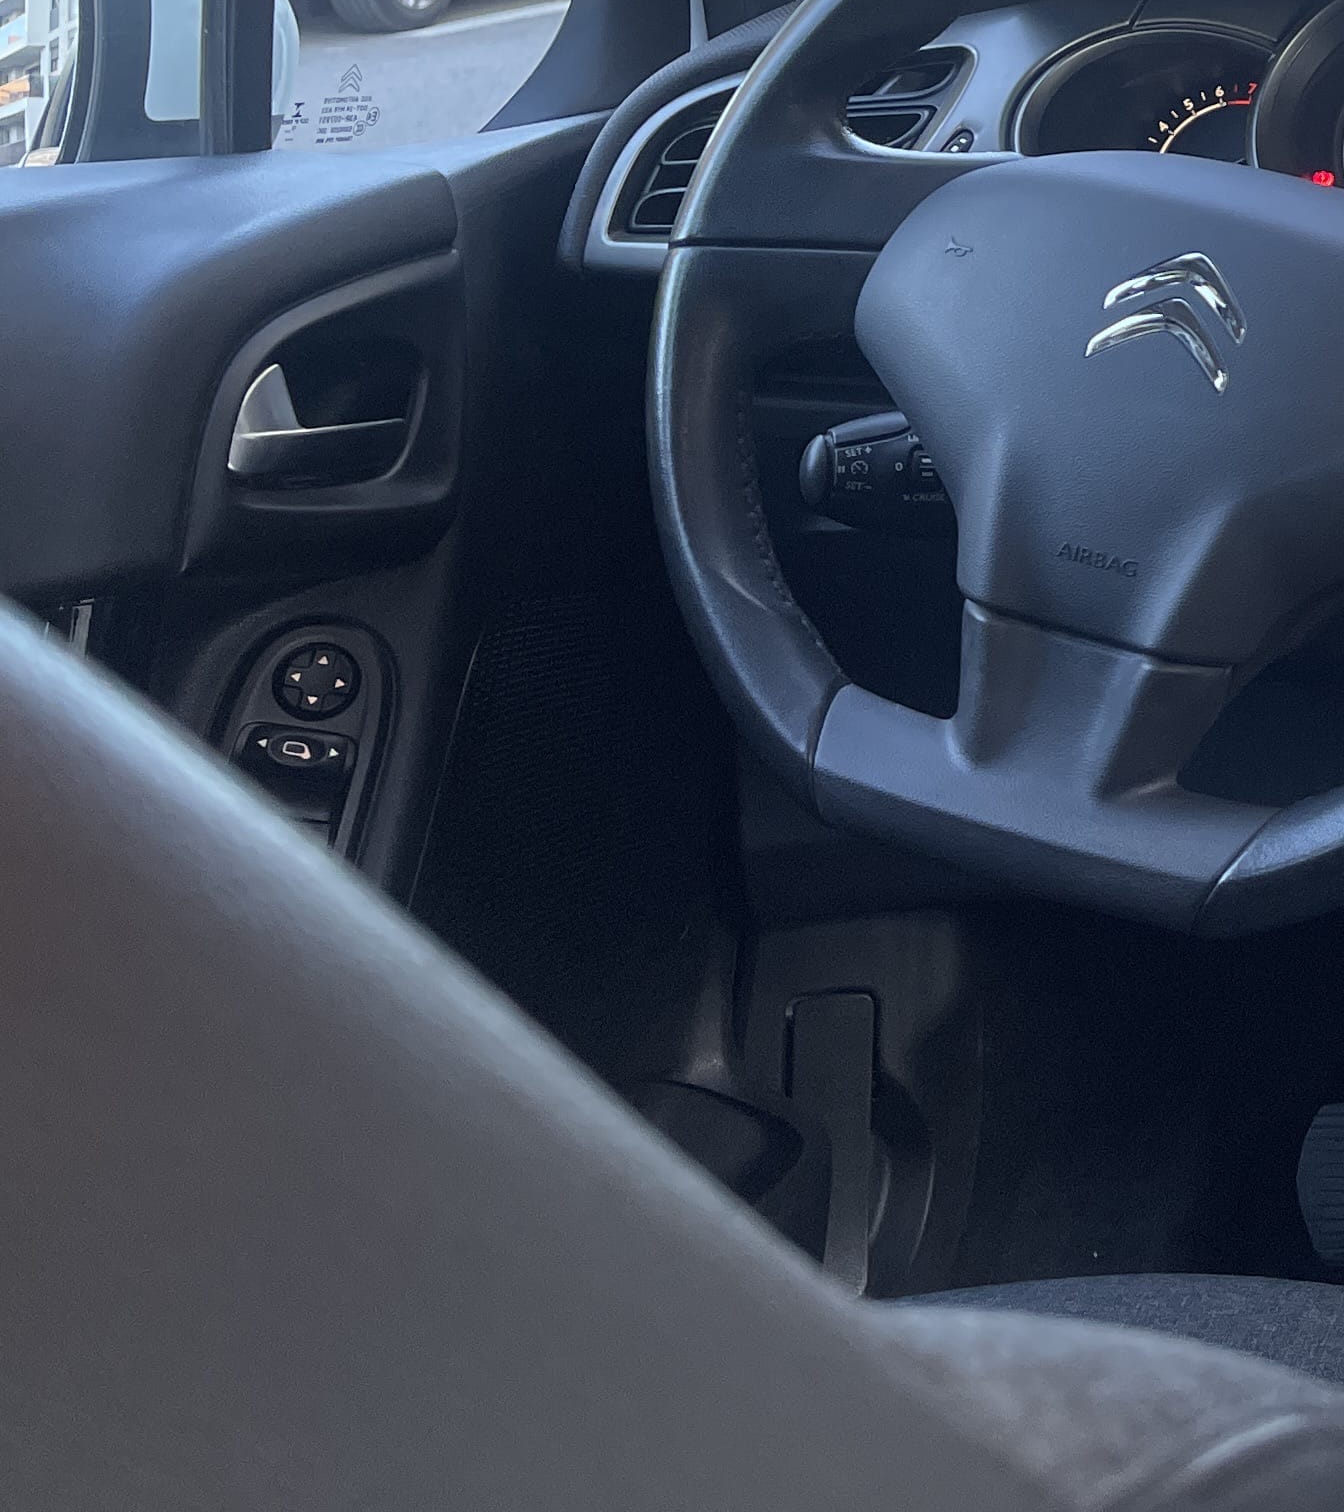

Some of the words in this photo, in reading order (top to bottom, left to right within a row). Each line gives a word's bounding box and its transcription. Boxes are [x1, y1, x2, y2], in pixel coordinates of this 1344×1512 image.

[1215, 85, 1225, 97] 6
[1248, 82, 1258, 94] 7
[1182, 98, 1194, 110] 5
[1158, 121, 1169, 132] 4
[845, 447, 862, 458] SET
[1056, 541, 1139, 578] AIRBAG
